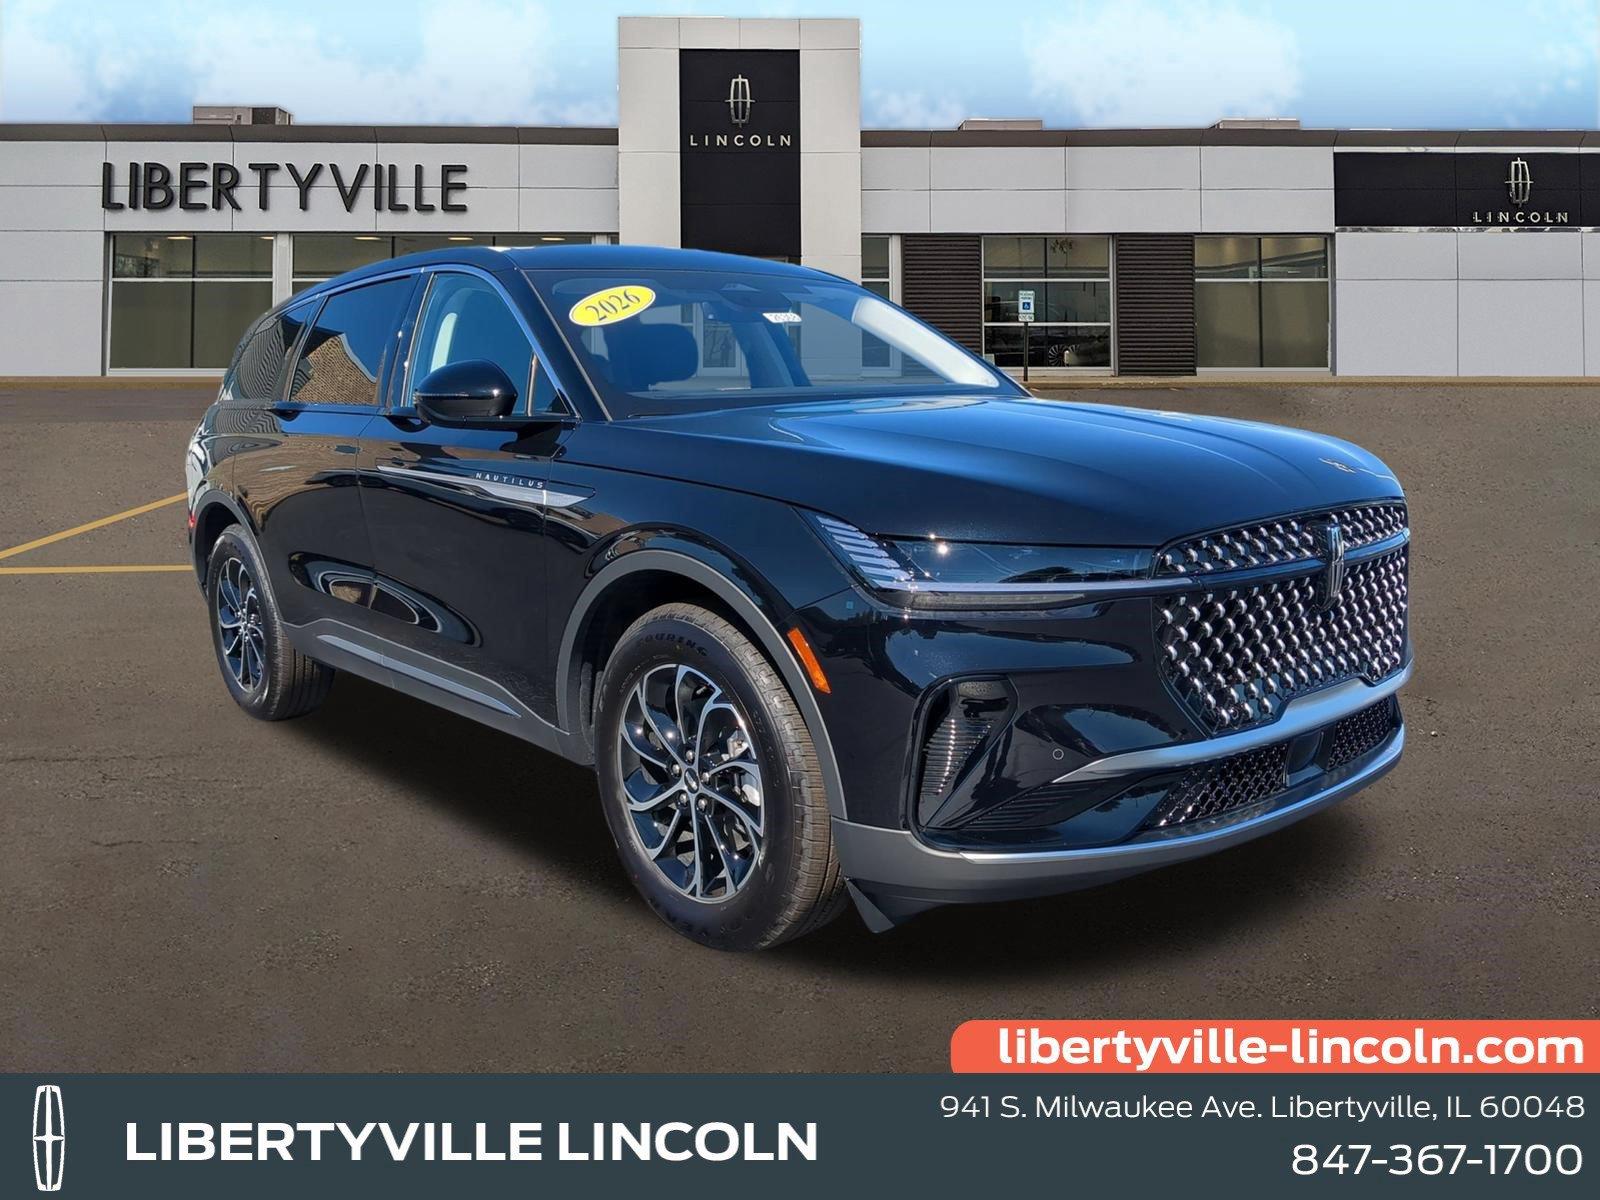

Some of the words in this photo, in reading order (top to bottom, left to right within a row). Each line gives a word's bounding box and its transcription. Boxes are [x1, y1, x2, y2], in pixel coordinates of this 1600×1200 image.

[689, 134, 792, 147] LINCOLN
[101, 162, 469, 213] LIBERTYVILLE
[1472, 211, 1568, 223] LINCOLN
[585, 289, 641, 321] 2026
[475, 472, 544, 489] NAUTILUS
